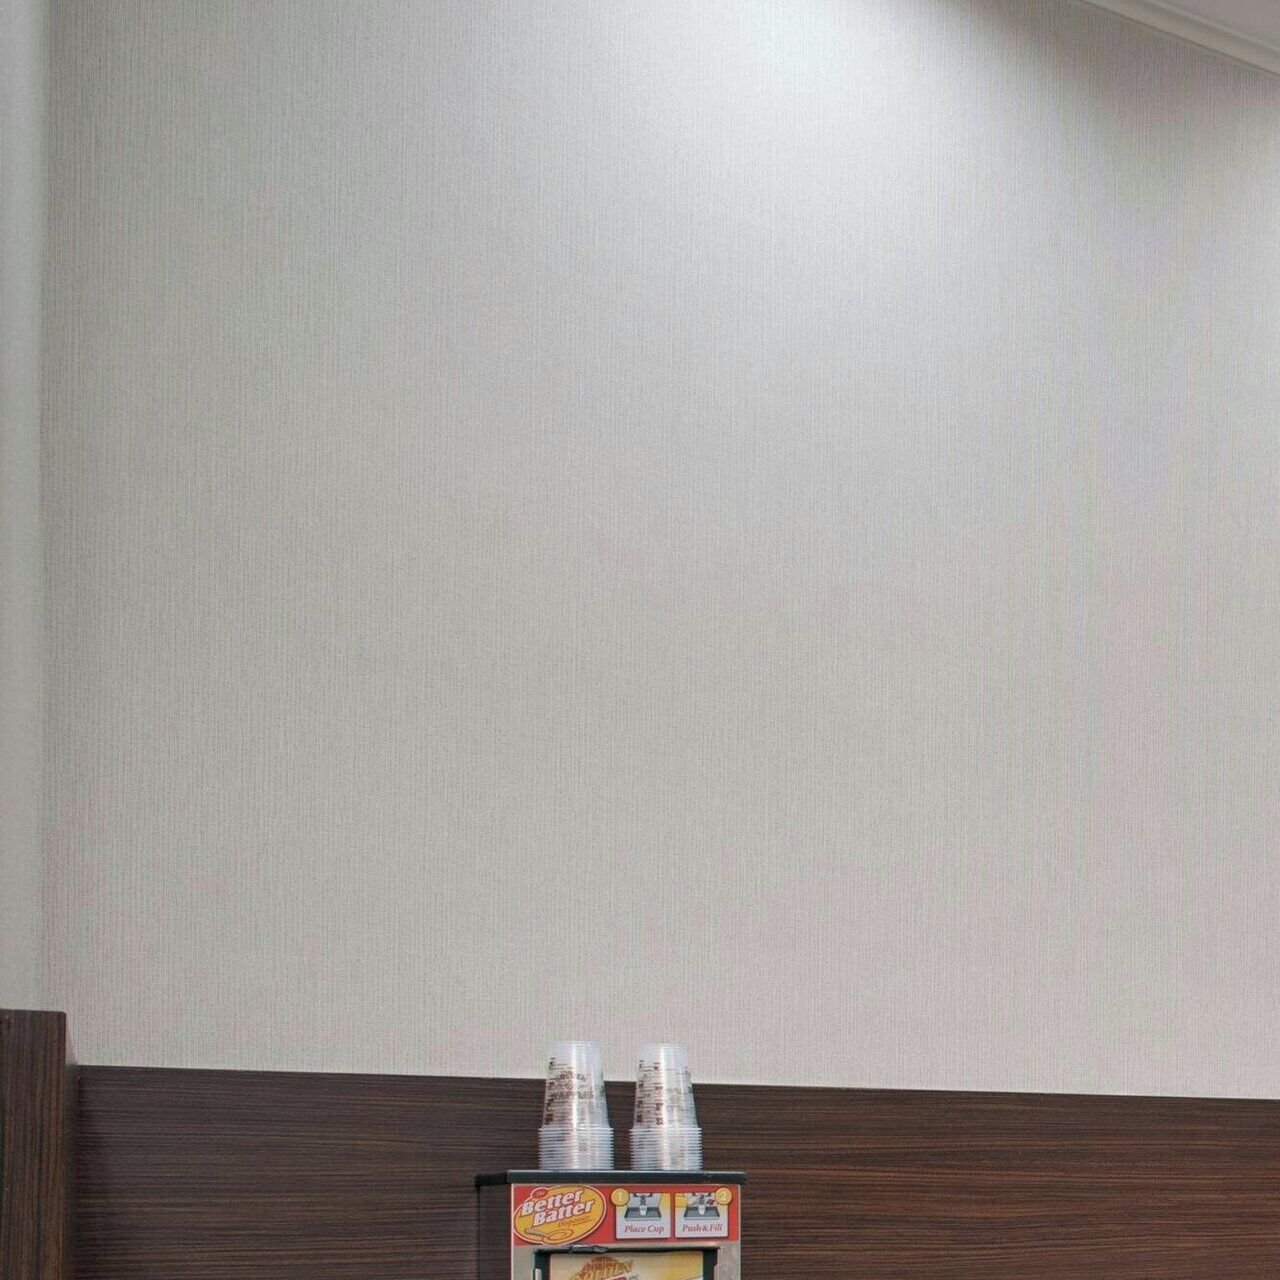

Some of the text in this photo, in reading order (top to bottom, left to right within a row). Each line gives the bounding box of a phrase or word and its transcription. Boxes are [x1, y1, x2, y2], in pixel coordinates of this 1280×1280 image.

[520, 1189, 583, 1217] Better
[532, 1199, 595, 1227] Batter
[624, 1224, 664, 1235] Place Cup
